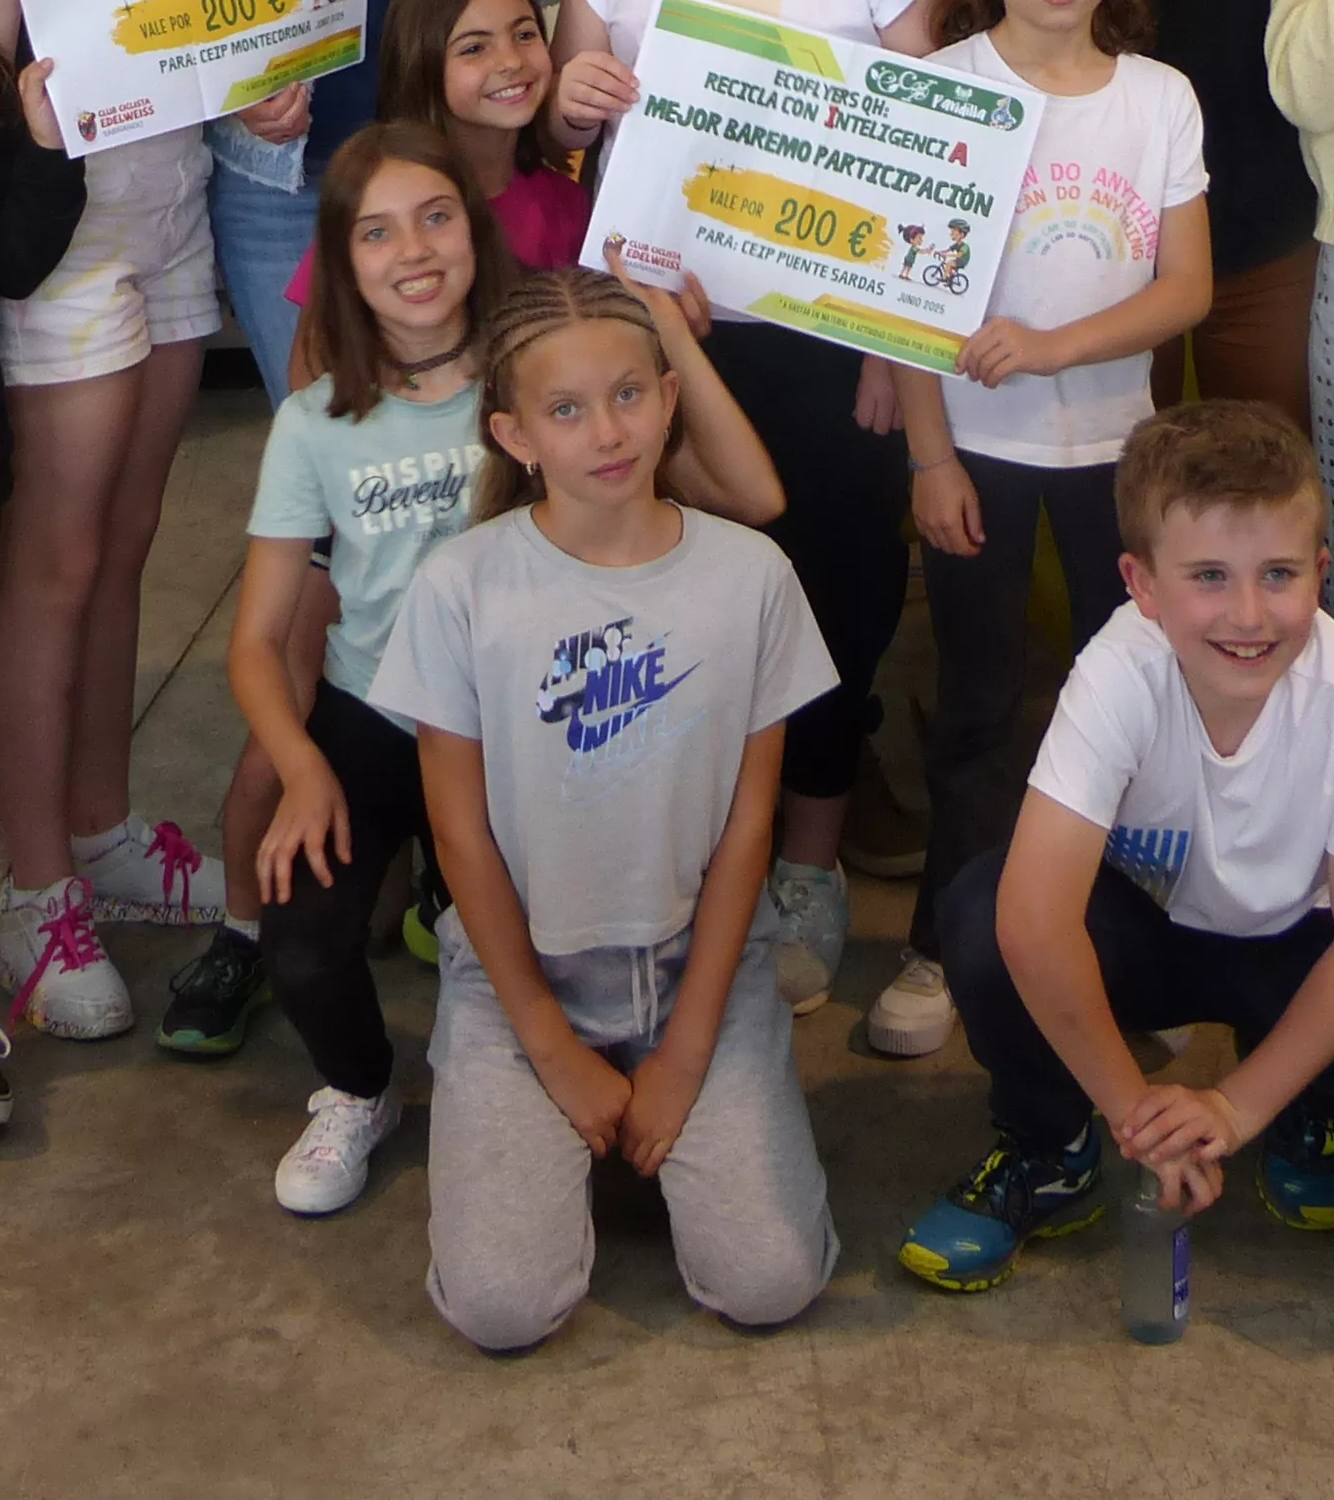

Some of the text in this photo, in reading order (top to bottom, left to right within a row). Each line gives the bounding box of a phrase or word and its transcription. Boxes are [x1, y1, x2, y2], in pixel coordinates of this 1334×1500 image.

[139, 14, 168, 40] VALE
[169, 12, 192, 30] POR
[159, 19, 311, 75] PARA: CEIP MONTECORONA
[99, 104, 156, 128] EDELWEISS
[704, 71, 778, 110] RECICLA
[781, 96, 820, 123] CON
[774, 69, 890, 119] ECOFLYERS QH:
[643, 94, 995, 218] MEJOR BAREMO PARTICIPACIÓN
[1050, 162, 1081, 182] DO
[709, 188, 737, 211] VALE
[739, 197, 765, 219] POR
[774, 198, 838, 247] 200
[1055, 185, 1081, 201] DO
[625, 248, 682, 272] EDELWEISS
[695, 225, 886, 296] PARA: CEIP PUENTE SARDAS
[351, 462, 467, 518] Beverly
[582, 647, 666, 716] NIKE
